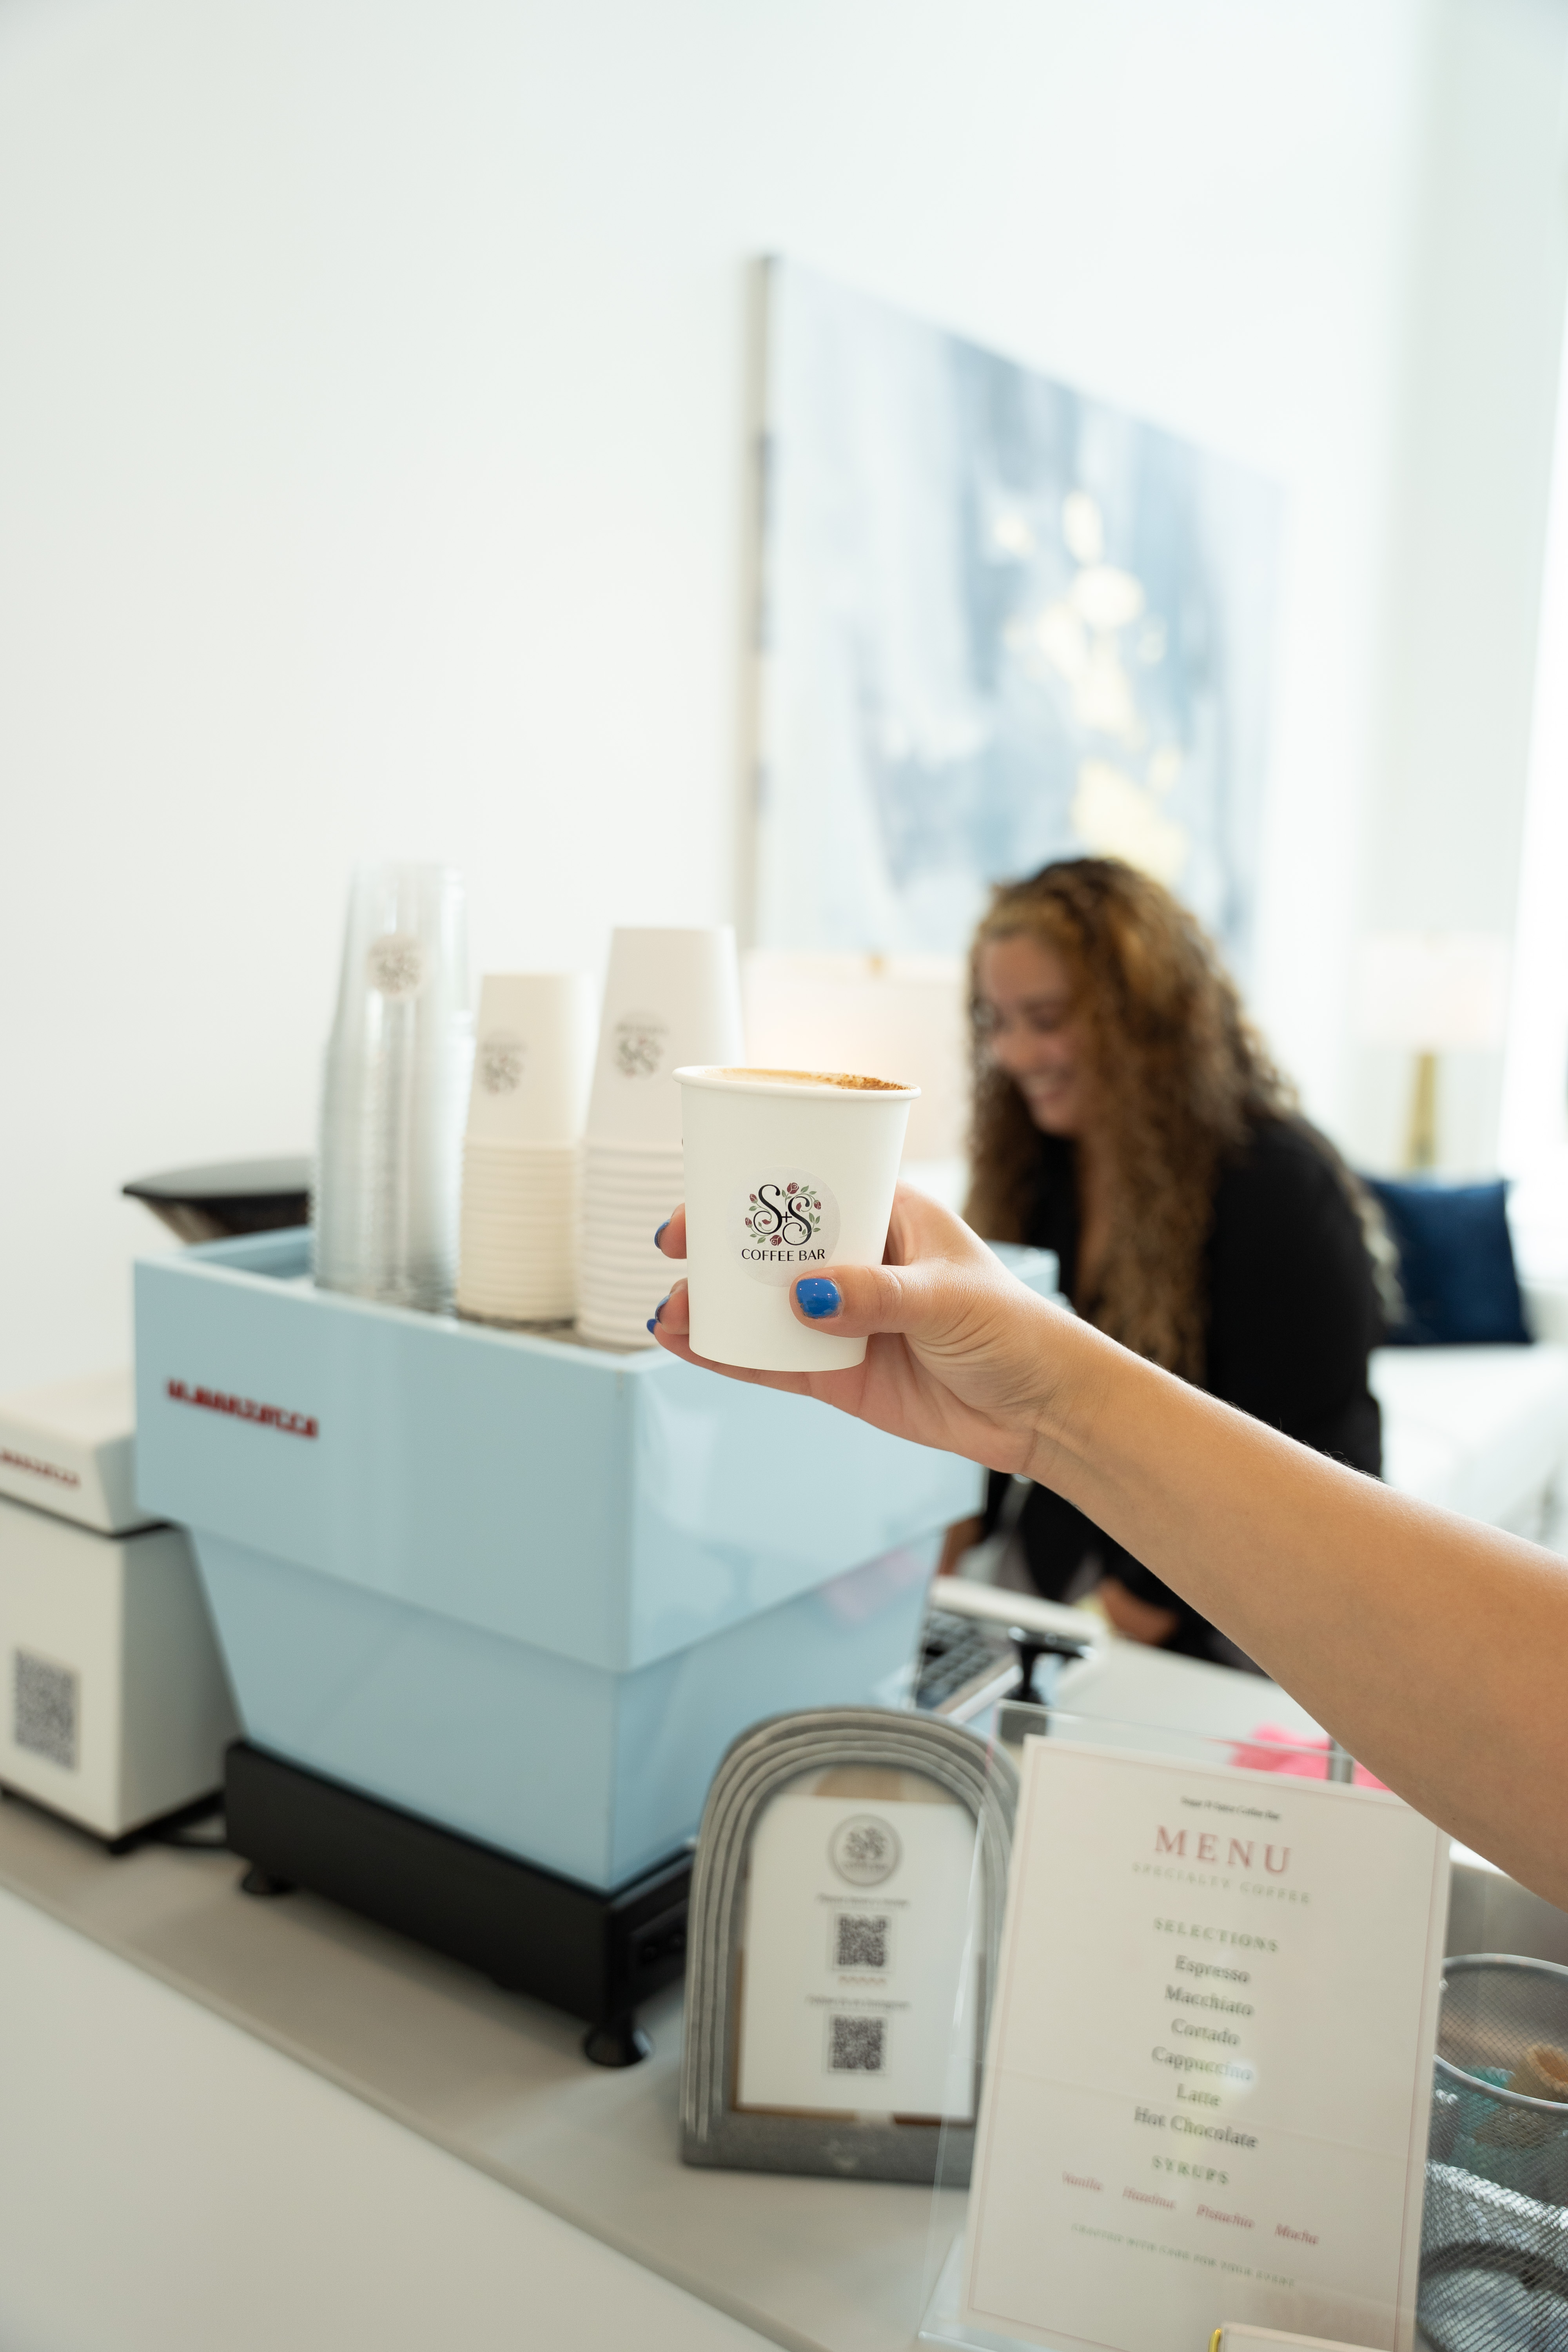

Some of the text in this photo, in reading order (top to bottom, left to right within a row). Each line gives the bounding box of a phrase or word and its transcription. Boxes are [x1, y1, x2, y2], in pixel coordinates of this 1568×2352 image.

[741, 1249, 826, 1261] COFFEE BAR
[1155, 1825, 1292, 1875] MENU
[1132, 1862, 1311, 1904] SPECIALTY COFFEE
[1153, 1917, 1279, 1953] SELECTIONS
[1175, 1955, 1251, 1982] Espresso
[1165, 1984, 1254, 2016] Macchiato
[1171, 2018, 1241, 2045] Cortado
[1151, 2046, 1254, 2080] Cappuccino
[1177, 2083, 1222, 2106] Latte
[1134, 2105, 1259, 2147] Hot Chocolate
[1152, 2155, 1229, 2185] SYRUPS
[1274, 2223, 1319, 2246] Mocha
